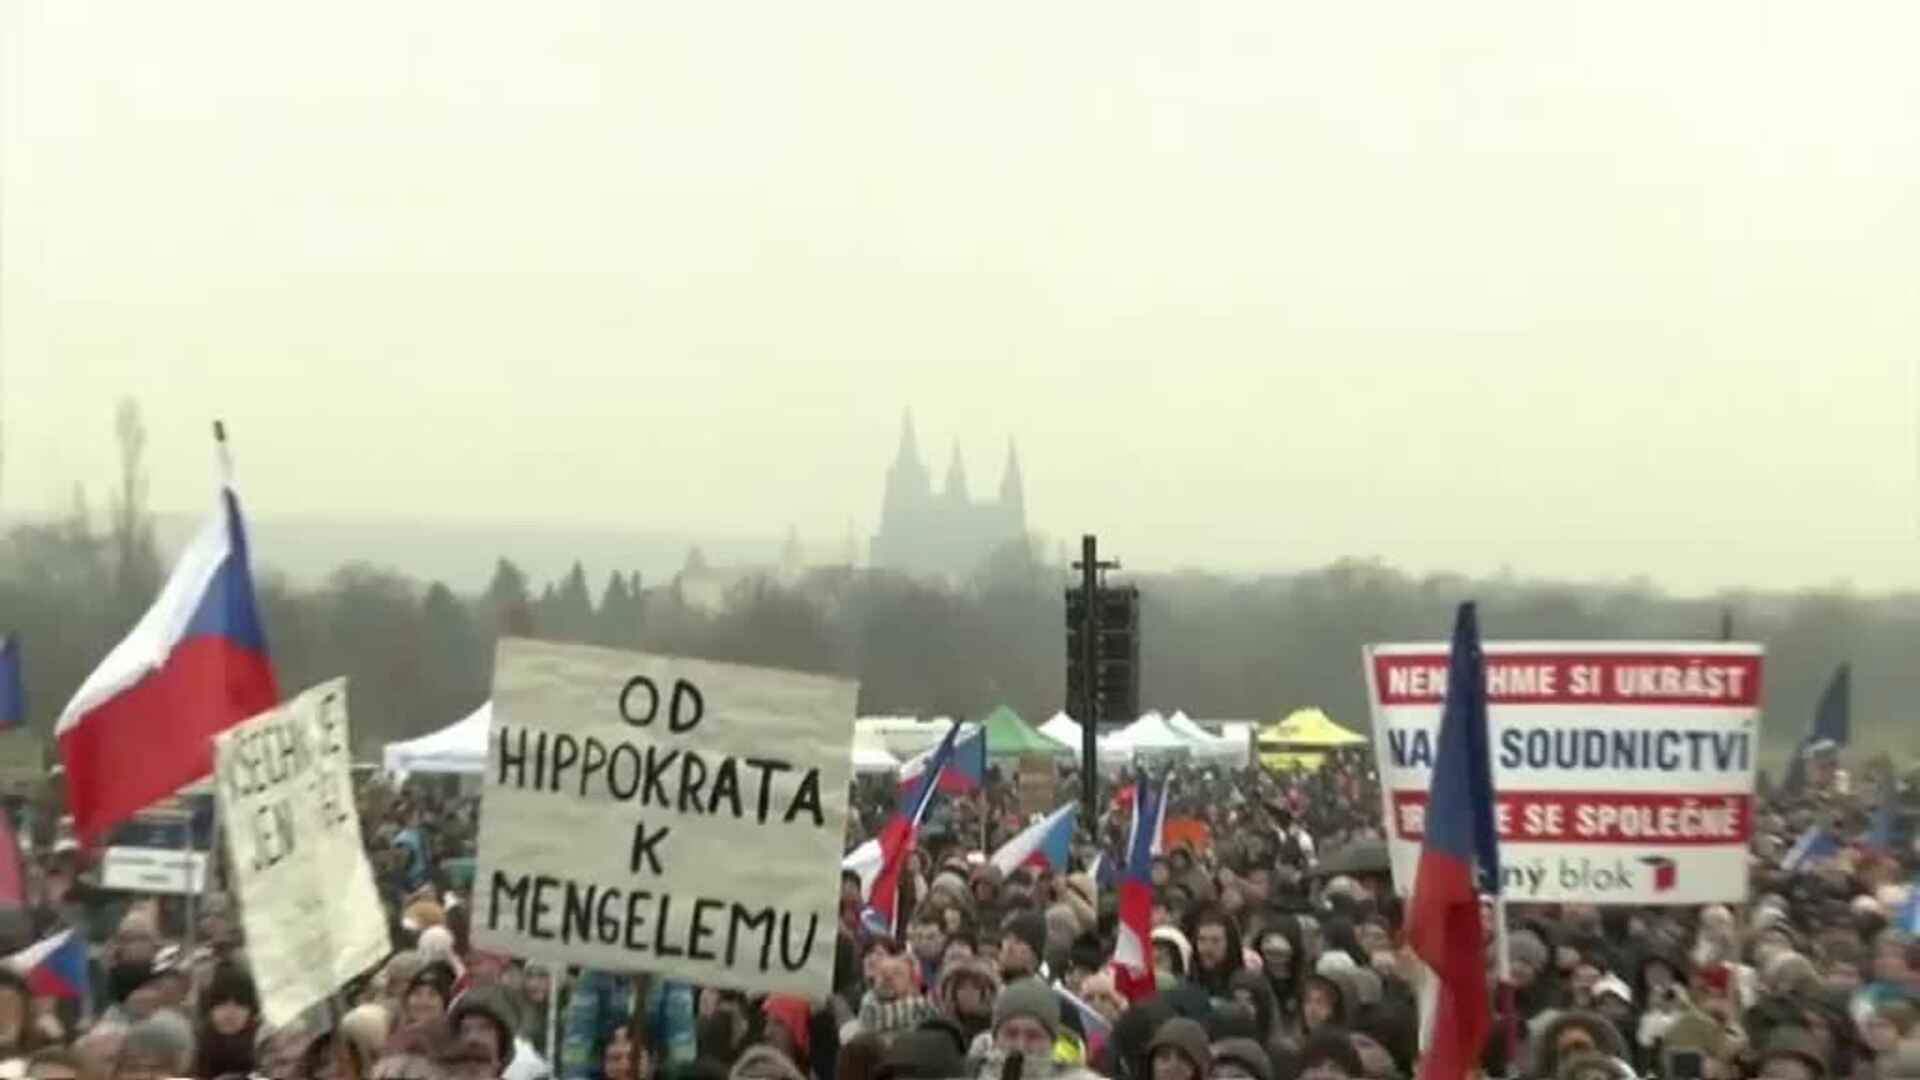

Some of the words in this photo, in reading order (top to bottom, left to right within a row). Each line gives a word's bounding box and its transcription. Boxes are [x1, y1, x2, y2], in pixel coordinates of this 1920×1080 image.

[619, 675, 704, 733] OD
[1568, 665, 1602, 695] SI
[1614, 659, 1747, 698] UKRÁST
[1500, 719, 1752, 771] SOUDNICTVÍ
[498, 726, 825, 827] HIPPOKRATA
[1522, 803, 1565, 835] SE
[1575, 797, 1740, 838] SPOLEČNĚ
[630, 821, 670, 875] K
[1558, 856, 1635, 891] blok
[487, 870, 819, 972] MENGELEMU
